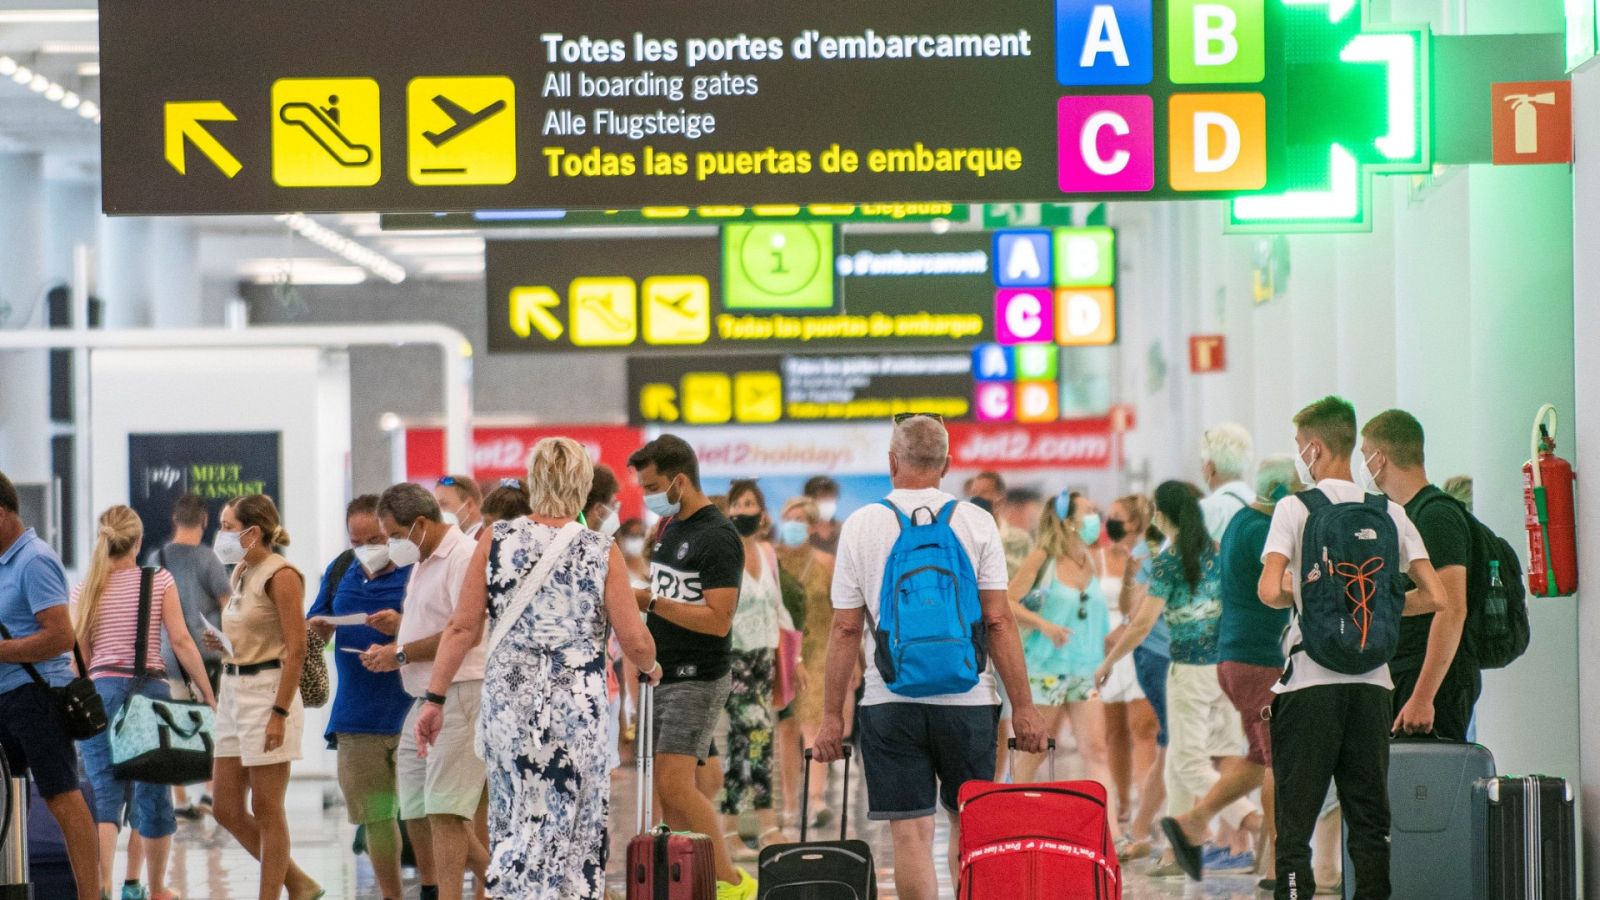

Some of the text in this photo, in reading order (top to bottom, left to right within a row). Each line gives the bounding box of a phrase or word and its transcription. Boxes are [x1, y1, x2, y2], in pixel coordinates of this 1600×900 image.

[540, 29, 1032, 67] Totes les portes d'embarcament
[1081, 4, 1239, 67] A B
[542, 71, 759, 102] All boarding gates
[542, 108, 716, 140] Alle Flugsteige
[1080, 111, 1241, 175] C D
[542, 143, 1022, 181] Todas las puertas de embarque
[1007, 237, 1102, 279] A B
[1005, 293, 1102, 338] C D
